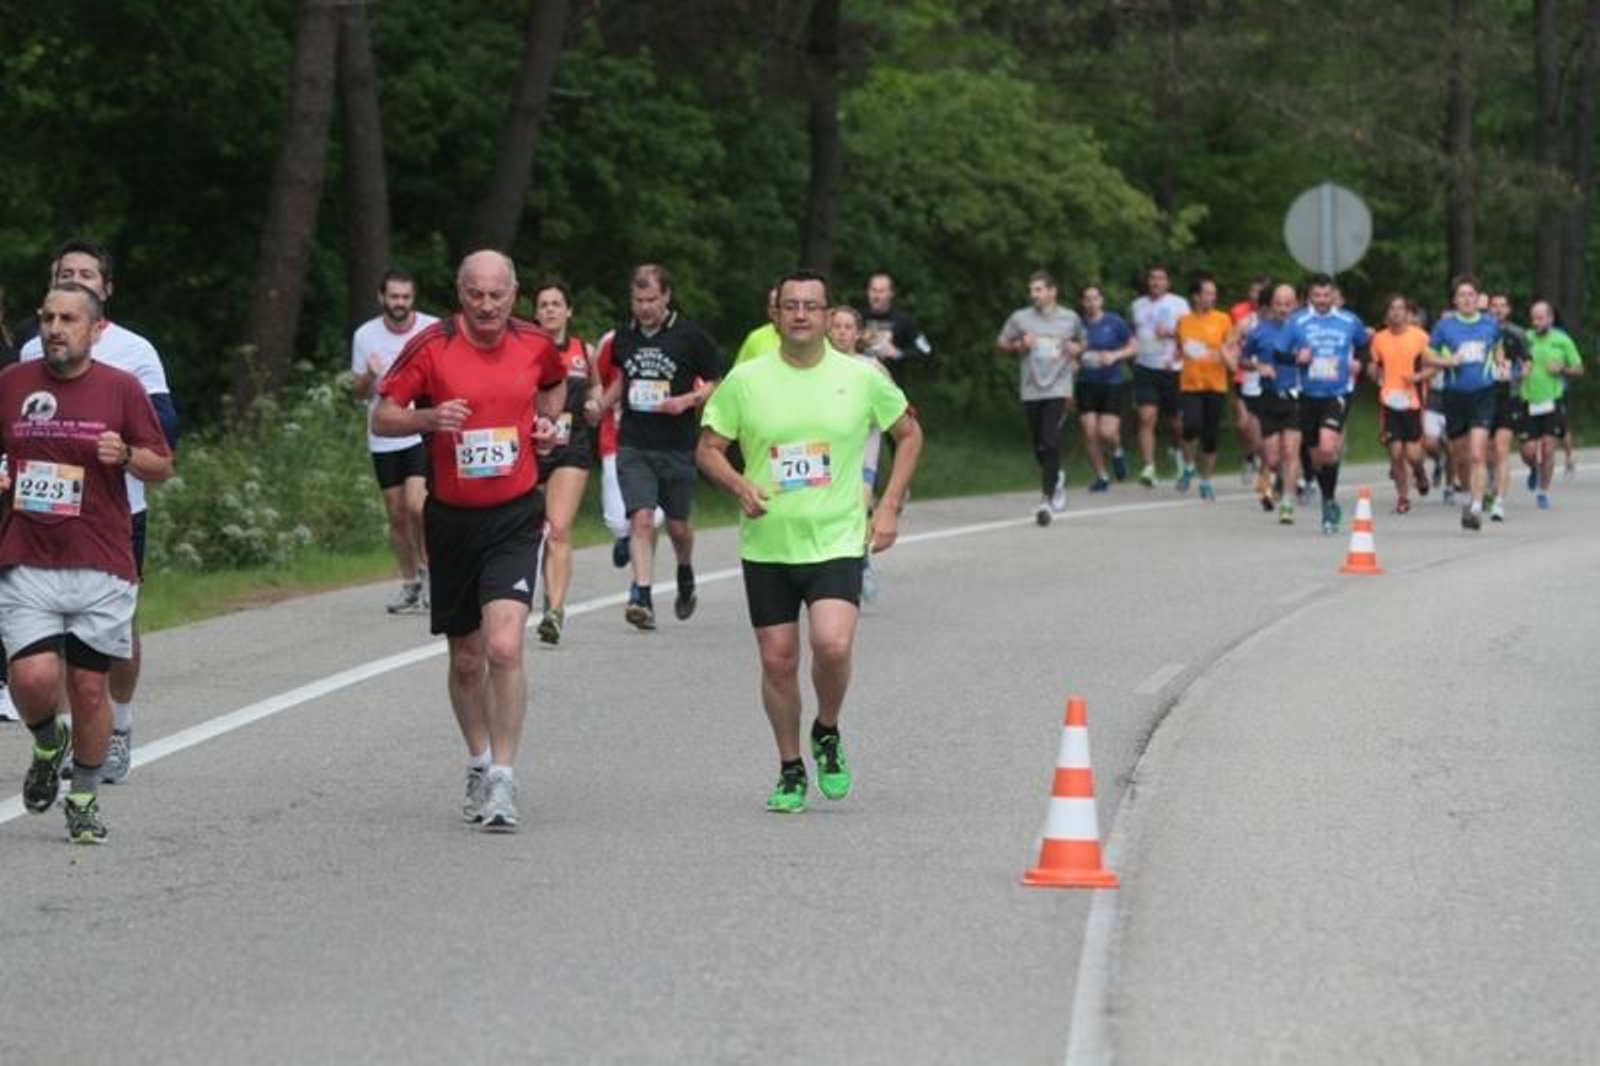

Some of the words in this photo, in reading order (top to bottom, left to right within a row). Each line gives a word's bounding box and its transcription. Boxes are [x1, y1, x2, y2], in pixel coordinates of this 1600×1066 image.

[461, 446, 505, 464] 378
[782, 459, 810, 477] 70
[20, 478, 65, 499] 223
